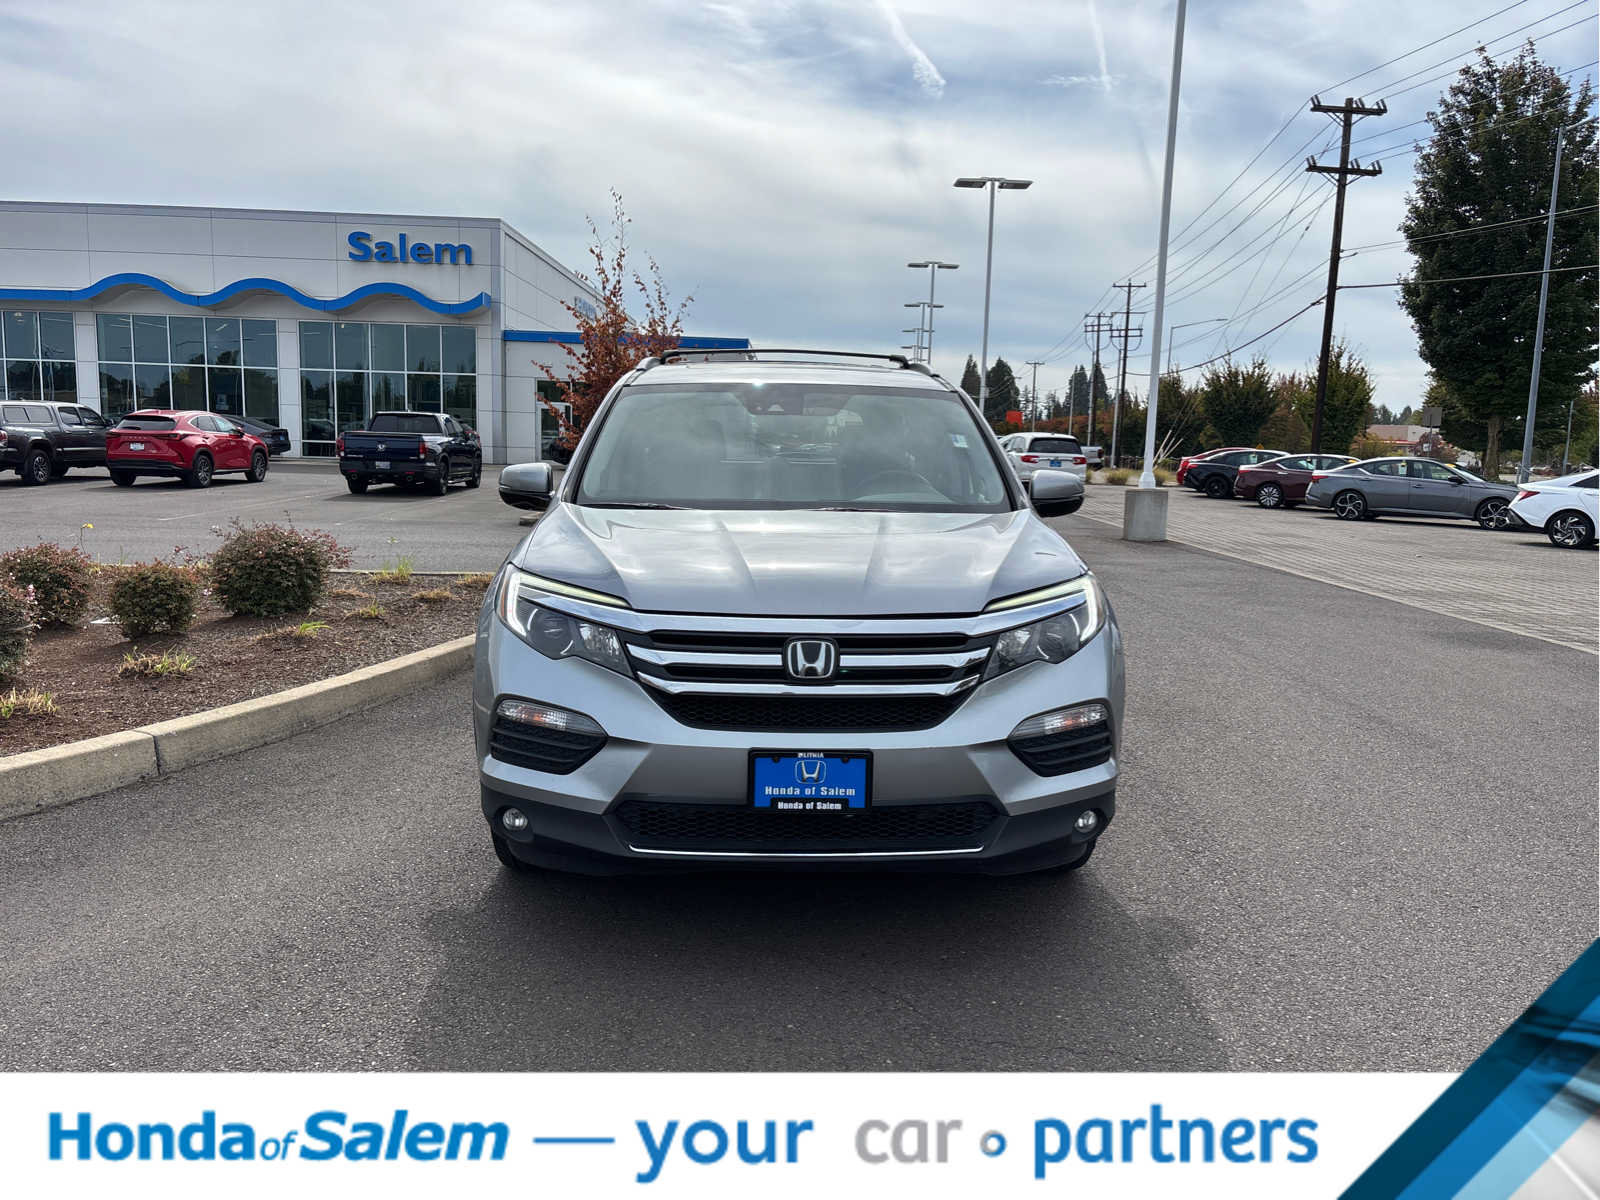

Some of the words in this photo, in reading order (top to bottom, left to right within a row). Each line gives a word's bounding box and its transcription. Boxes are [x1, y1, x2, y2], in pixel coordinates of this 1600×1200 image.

[347, 231, 473, 265] Salem
[765, 786, 800, 795] Honda
[805, 786, 816, 795] of
[820, 786, 856, 796] Salem
[816, 802, 842, 810] Salem
